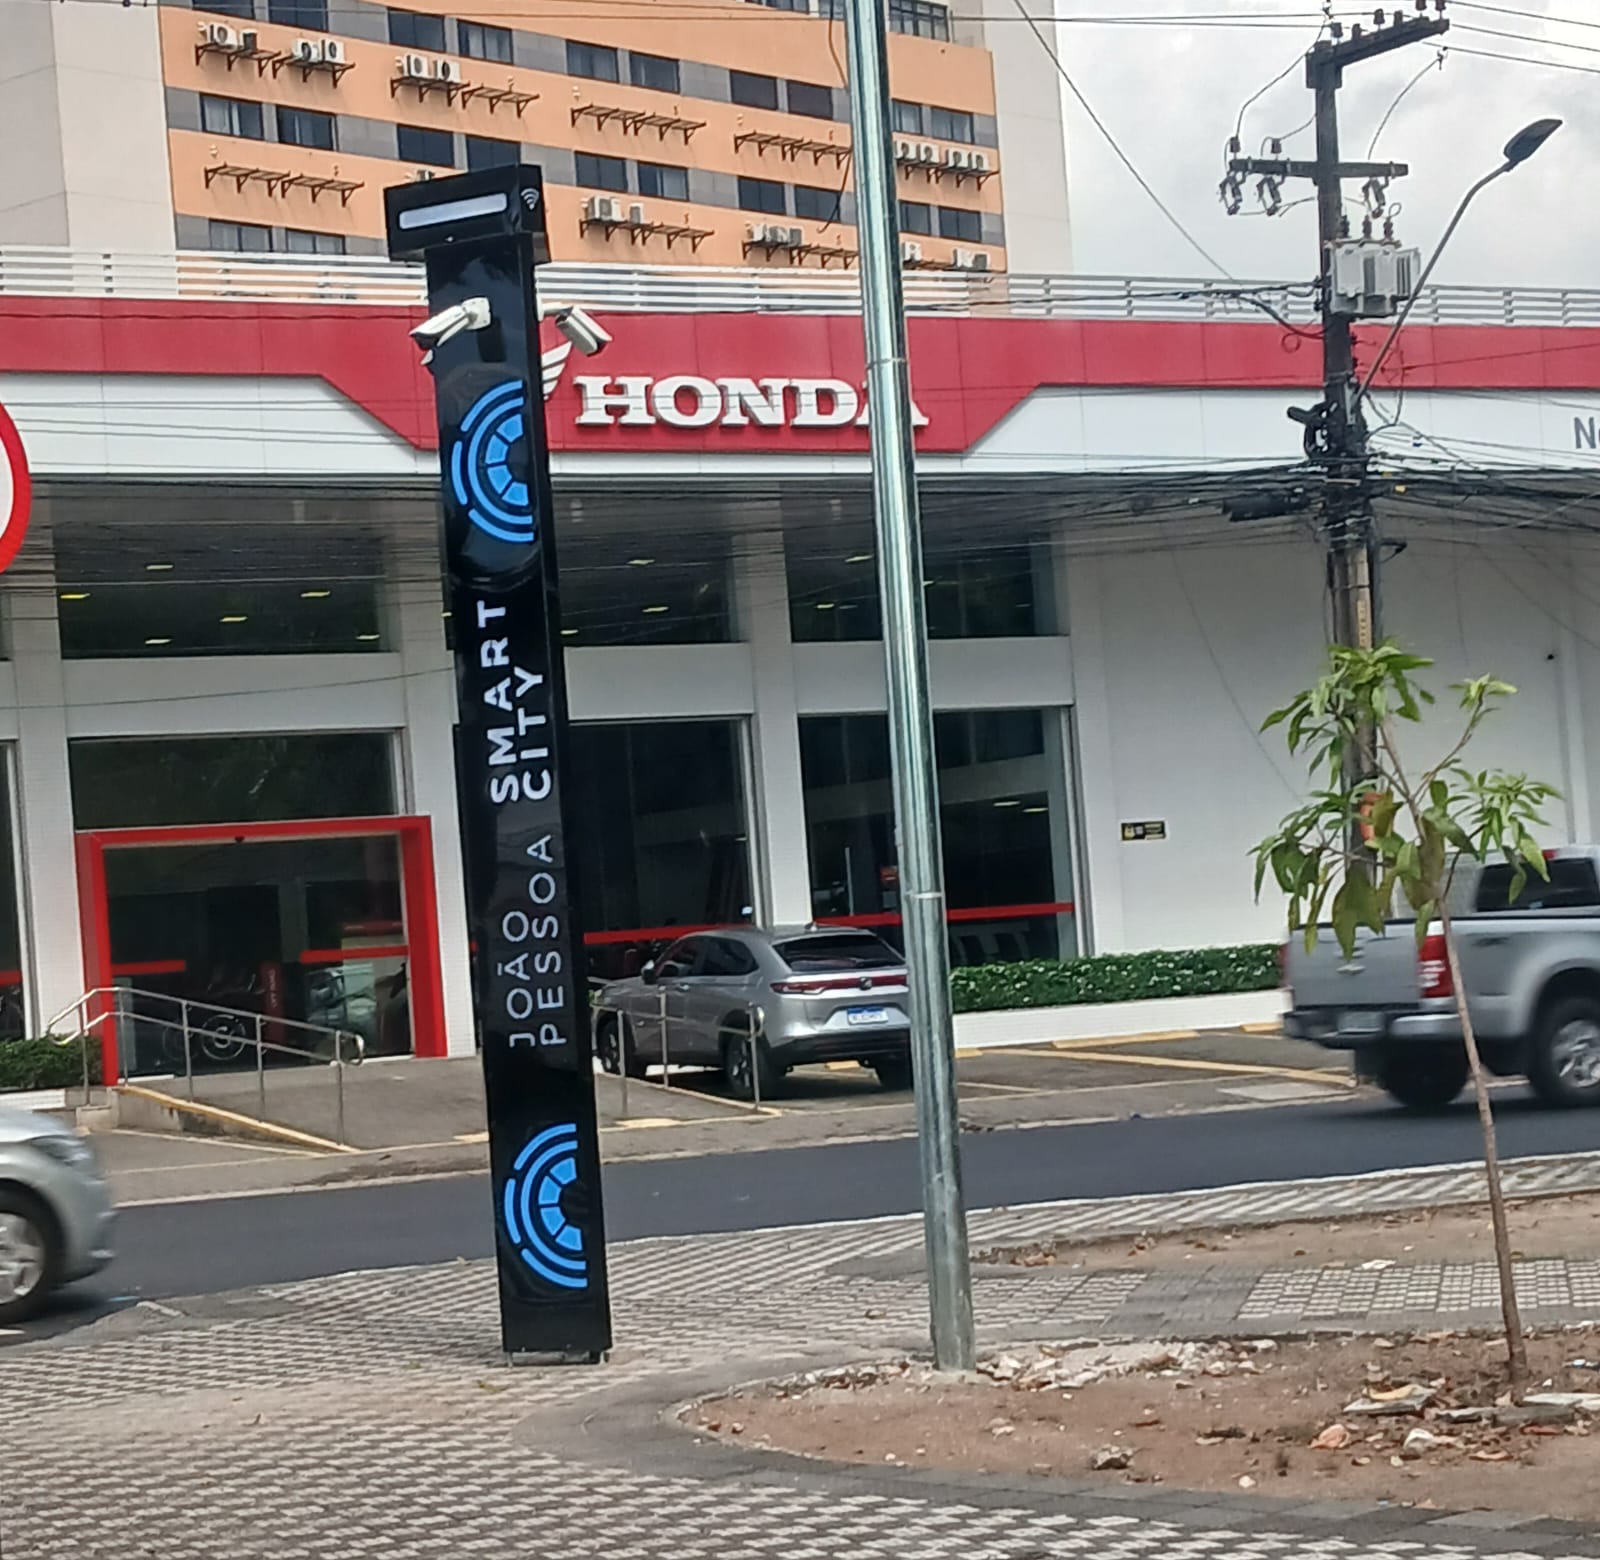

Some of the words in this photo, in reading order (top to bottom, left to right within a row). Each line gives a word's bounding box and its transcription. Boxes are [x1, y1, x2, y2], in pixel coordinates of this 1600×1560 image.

[1574, 416, 1600, 449] N
[476, 600, 519, 804] SMART
[514, 666, 551, 800] CITY
[497, 911, 536, 1047] JOÃO
[526, 834, 567, 1046] PESSOA
